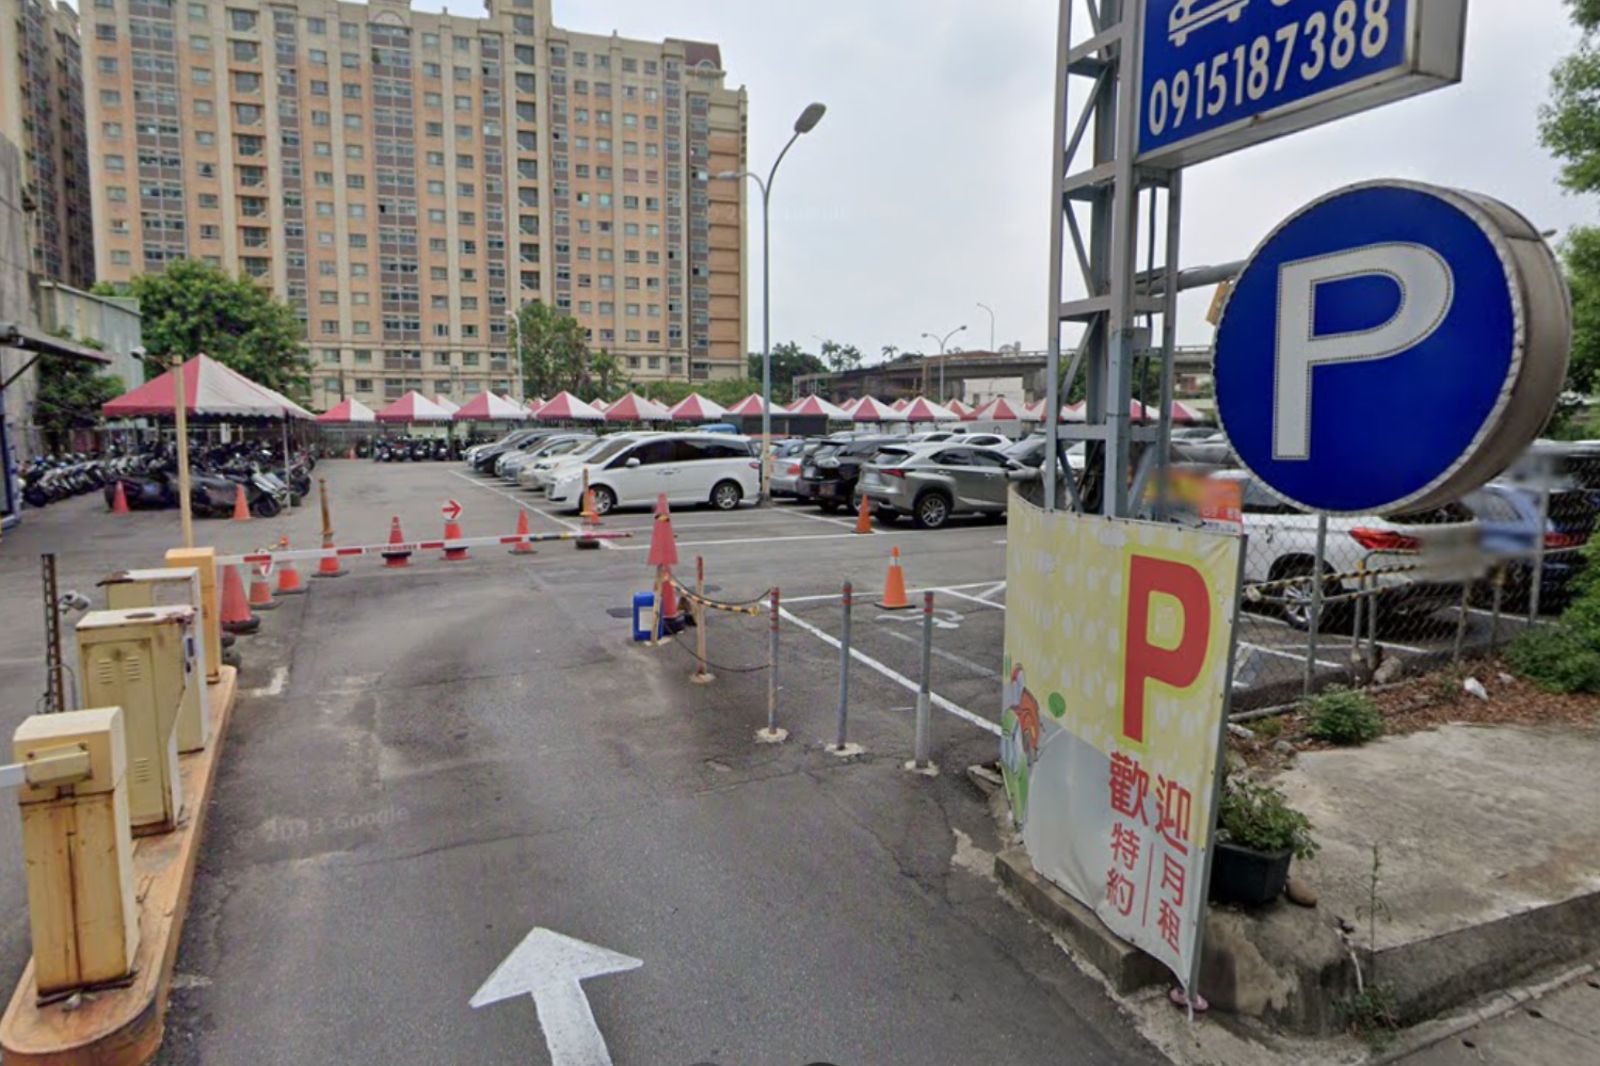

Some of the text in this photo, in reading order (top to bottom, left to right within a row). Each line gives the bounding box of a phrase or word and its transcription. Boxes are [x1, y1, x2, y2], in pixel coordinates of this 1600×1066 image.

[1149, 0, 1390, 136] 0915187388
[1272, 242, 1455, 461] P
[1123, 554, 1211, 743] P
[1108, 752, 1191, 856] 歡迎
[1105, 828, 1141, 917] 特約
[1157, 855, 1186, 956] 月租
